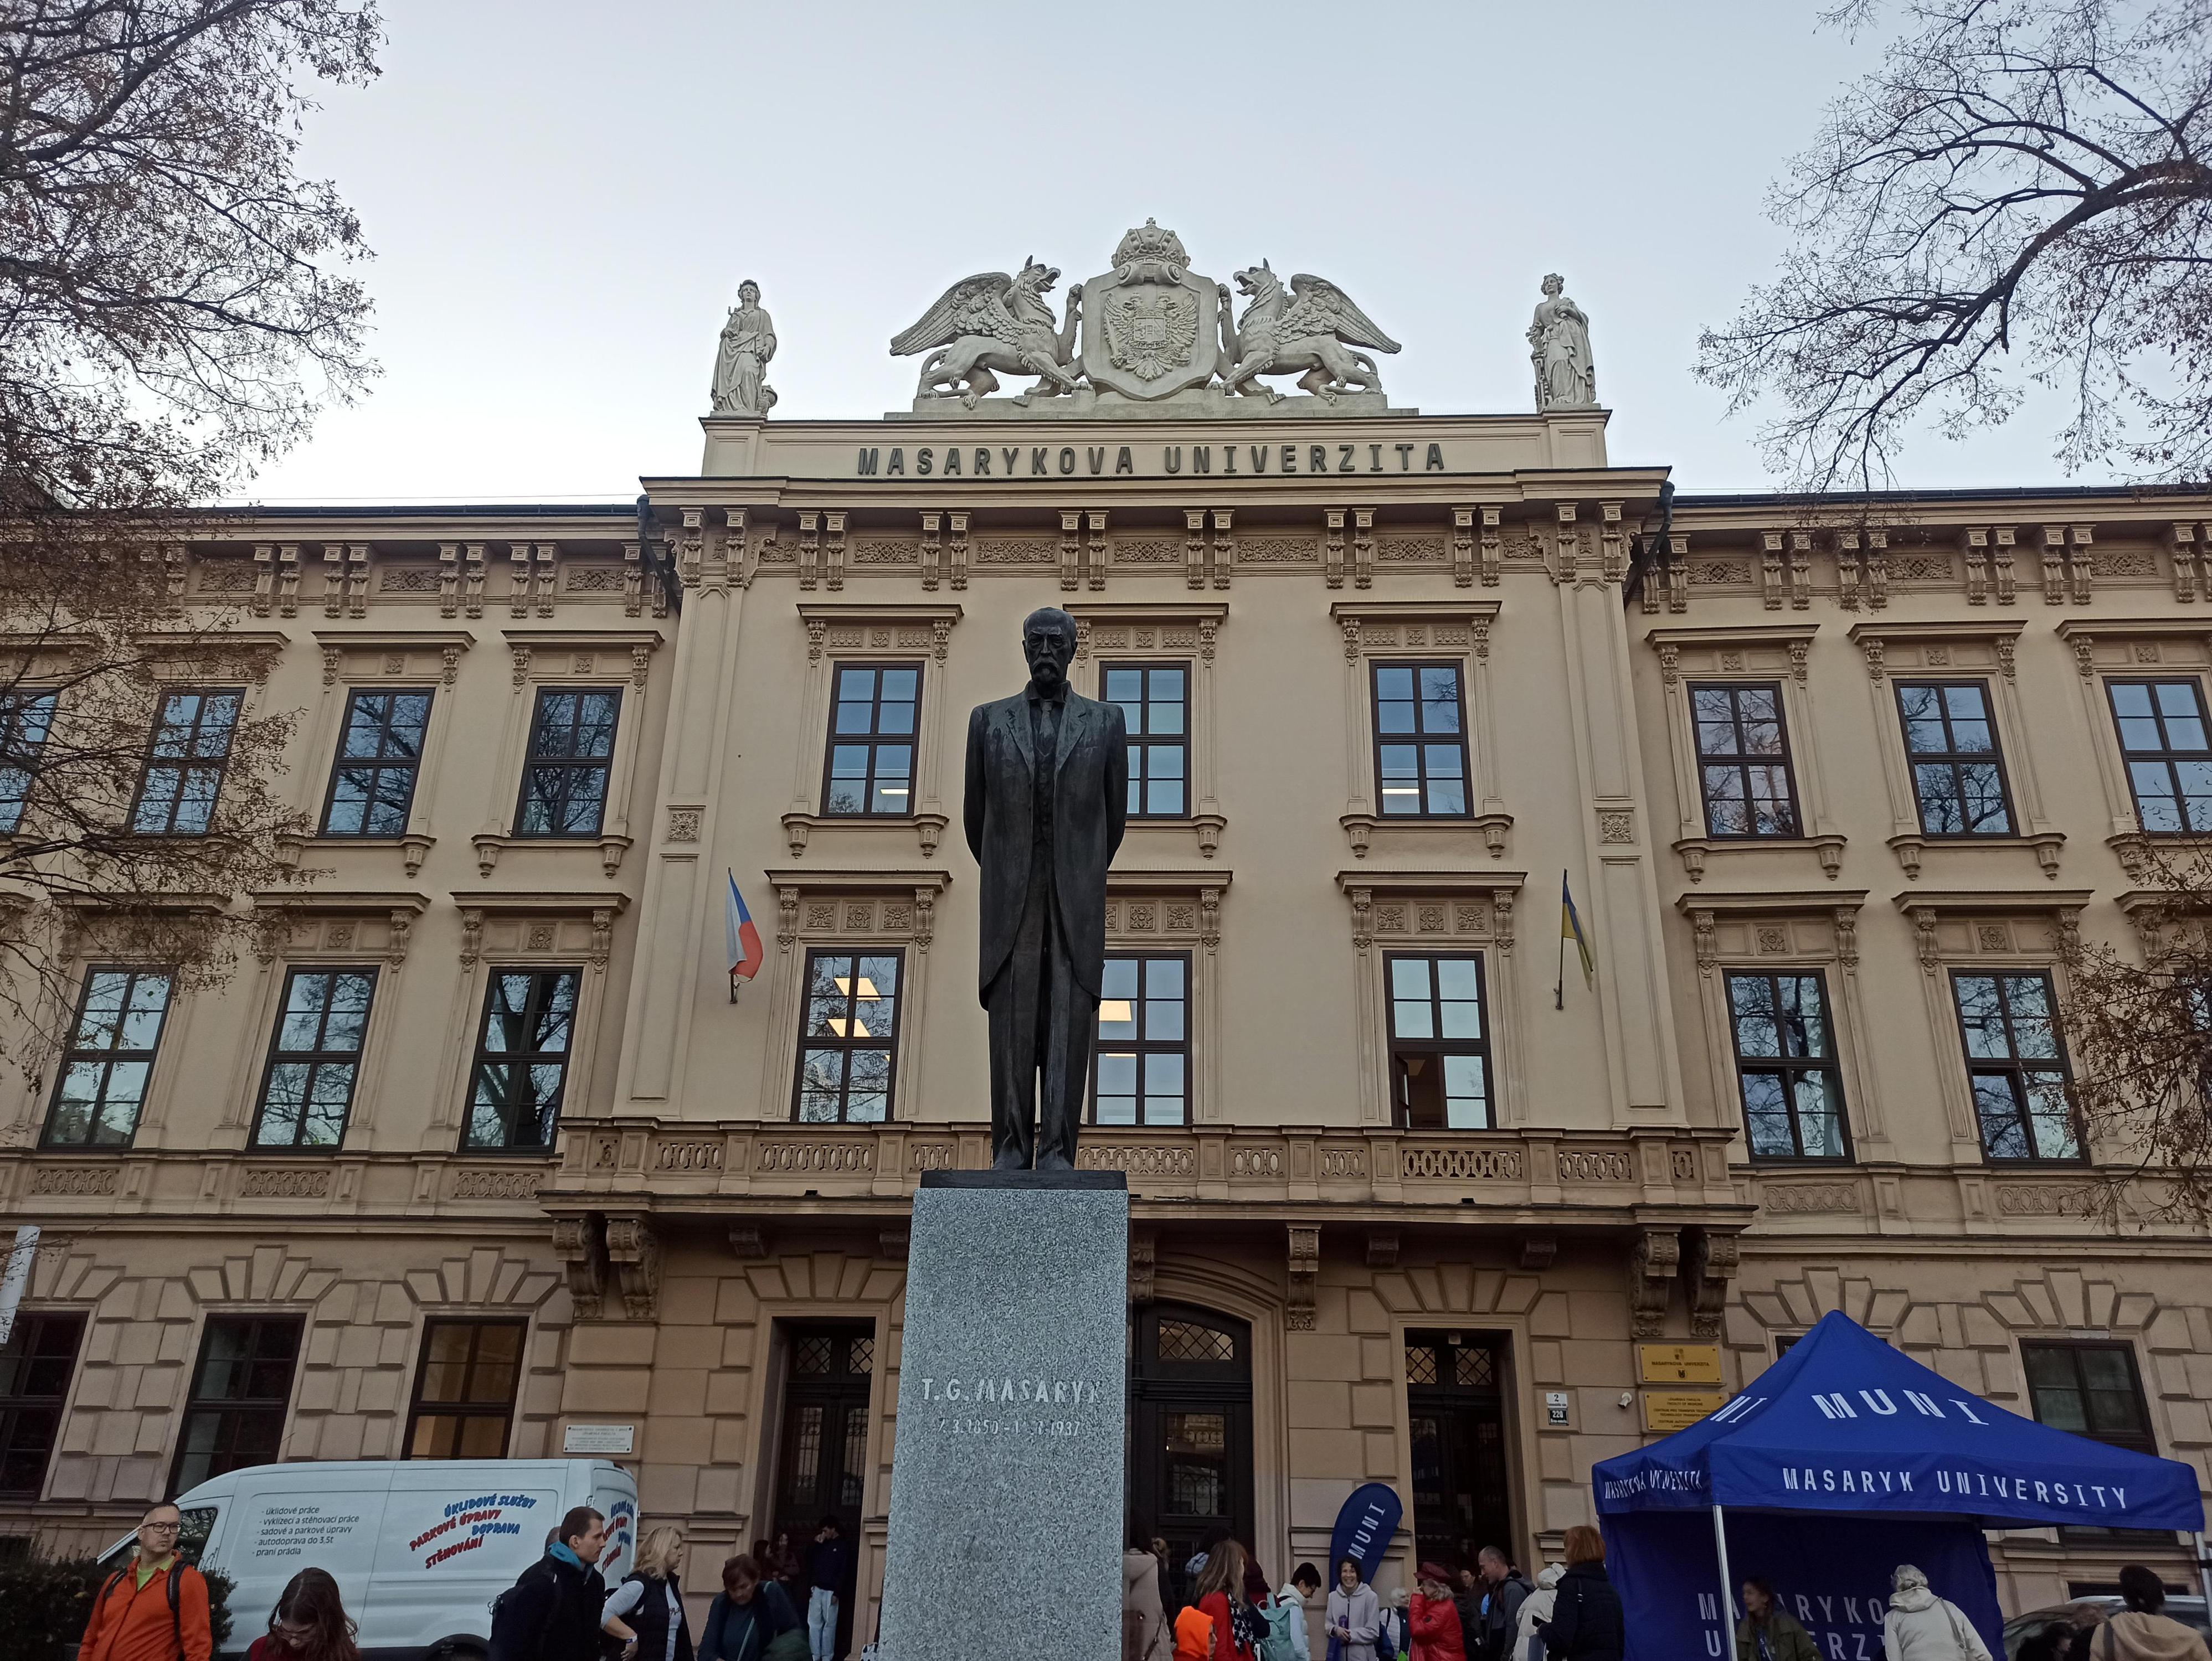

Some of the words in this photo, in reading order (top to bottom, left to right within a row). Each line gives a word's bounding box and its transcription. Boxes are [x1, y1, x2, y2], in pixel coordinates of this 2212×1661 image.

[857, 446, 1133, 474] MASARYKOVA
[1165, 443, 1445, 473] UNIVERZITA
[976, 1379, 1102, 1403] MASARYK
[1554, 1394, 1559, 1402] 2
[1811, 1388, 1989, 1426] MUNI
[1782, 1467, 1913, 1493] MASARYK
[1937, 1470, 2126, 1509] UNIVERSITY
[266, 1507, 297, 1515] úklidové
[299, 1506, 320, 1515] práce
[444, 1493, 497, 1518] ÚKLIDOVÉ
[498, 1494, 537, 1509] SLUŽBY
[261, 1528, 287, 1536] sadové
[294, 1526, 325, 1535] parkové
[301, 1515, 337, 1524] stěhovací
[338, 1515, 359, 1524] práce
[409, 1516, 456, 1551] PARKOVÉ
[459, 1509, 502, 1526] ÚPRAVY
[471, 1523, 521, 1536] DOPRAVA
[1347, 1502, 1385, 1560] MUNI
[256, 1548, 276, 1557] praní
[277, 1547, 301, 1556] prádla
[258, 1537, 306, 1546] autodoprava
[320, 1536, 334, 1545] 3,5t
[425, 1534, 485, 1569] STĚHOVÁNÍ
